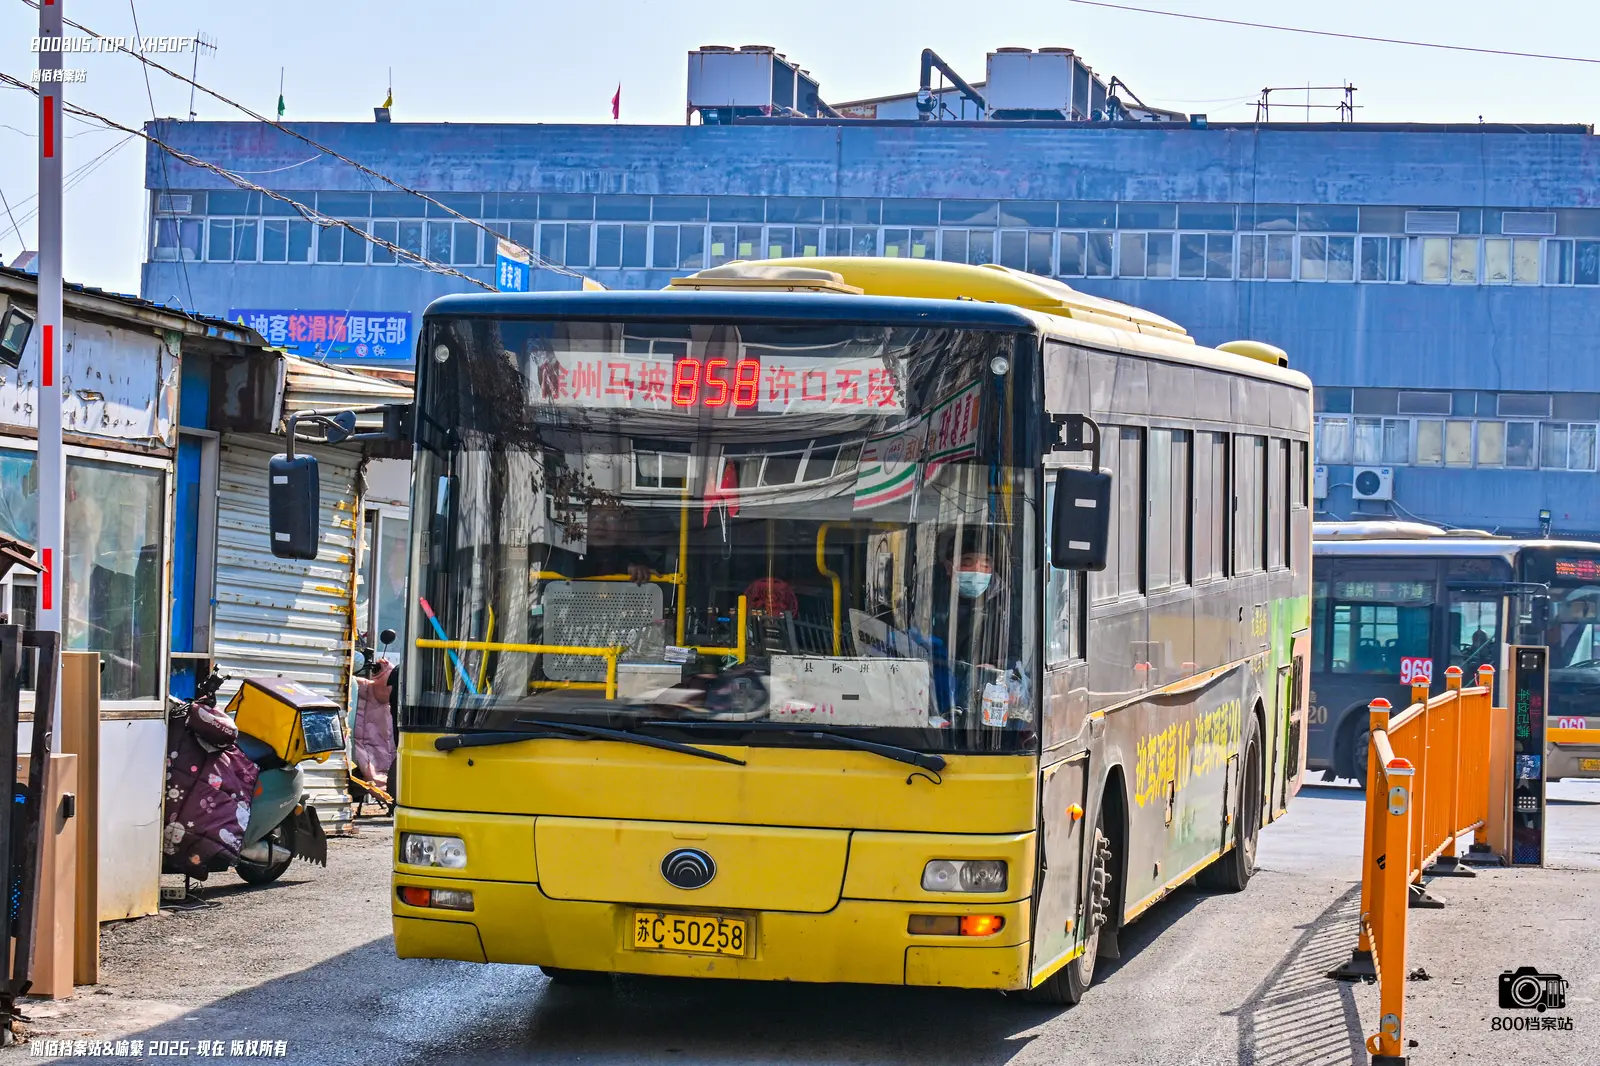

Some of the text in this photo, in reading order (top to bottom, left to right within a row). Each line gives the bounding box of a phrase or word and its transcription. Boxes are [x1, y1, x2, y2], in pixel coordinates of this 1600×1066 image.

[250, 314, 407, 345] 迪客轮滑场俱乐部
[673, 358, 761, 408] 858
[764, 364, 898, 408] 许口五段
